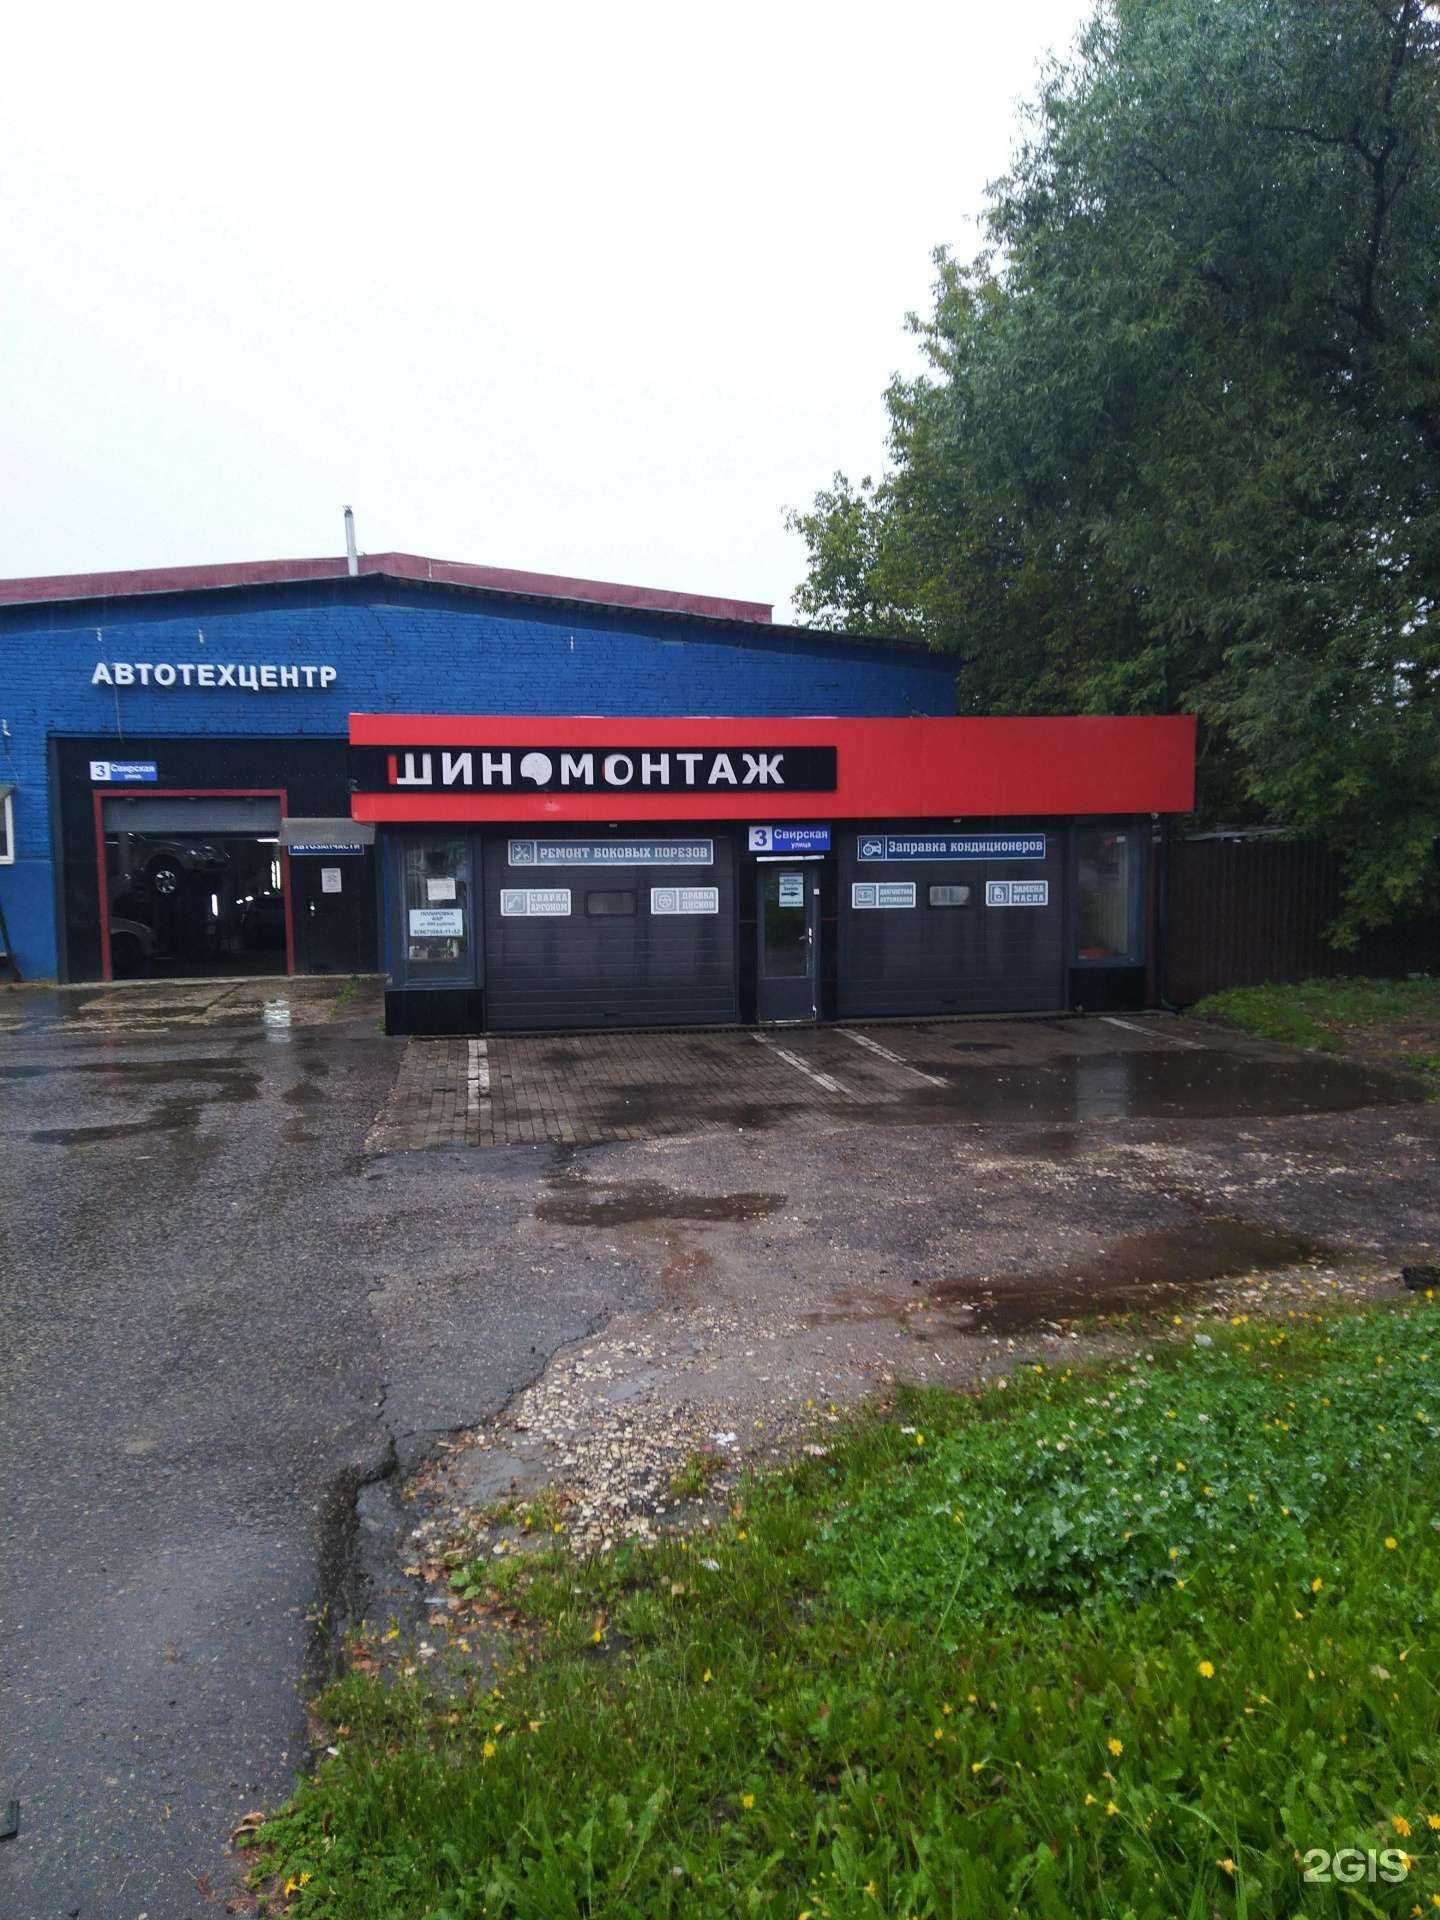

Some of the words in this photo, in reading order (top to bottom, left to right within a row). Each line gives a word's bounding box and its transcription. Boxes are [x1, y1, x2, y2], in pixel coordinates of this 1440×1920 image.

[91, 662, 337, 691] АВТОТЕХЦЕНТР
[95, 764, 106, 777] 3
[387, 751, 785, 786] ШИНОМОНТАЖ
[754, 829, 768, 847] 3
[773, 829, 828, 841] Свирская
[790, 841, 812, 849] улица
[888, 841, 947, 854] Заправка
[950, 839, 1043, 853] кондиционеров
[539, 847, 591, 859] РЕМОНТ
[593, 847, 652, 859] БОКОВЫХ
[654, 847, 709, 858] ПОРЕЗОВ
[1013, 885, 1044, 893] ЗАМЕНА
[530, 893, 568, 902] СВАРКА
[1013, 894, 1044, 902] МАСЛА
[530, 903, 568, 912] АРГОНОМ
